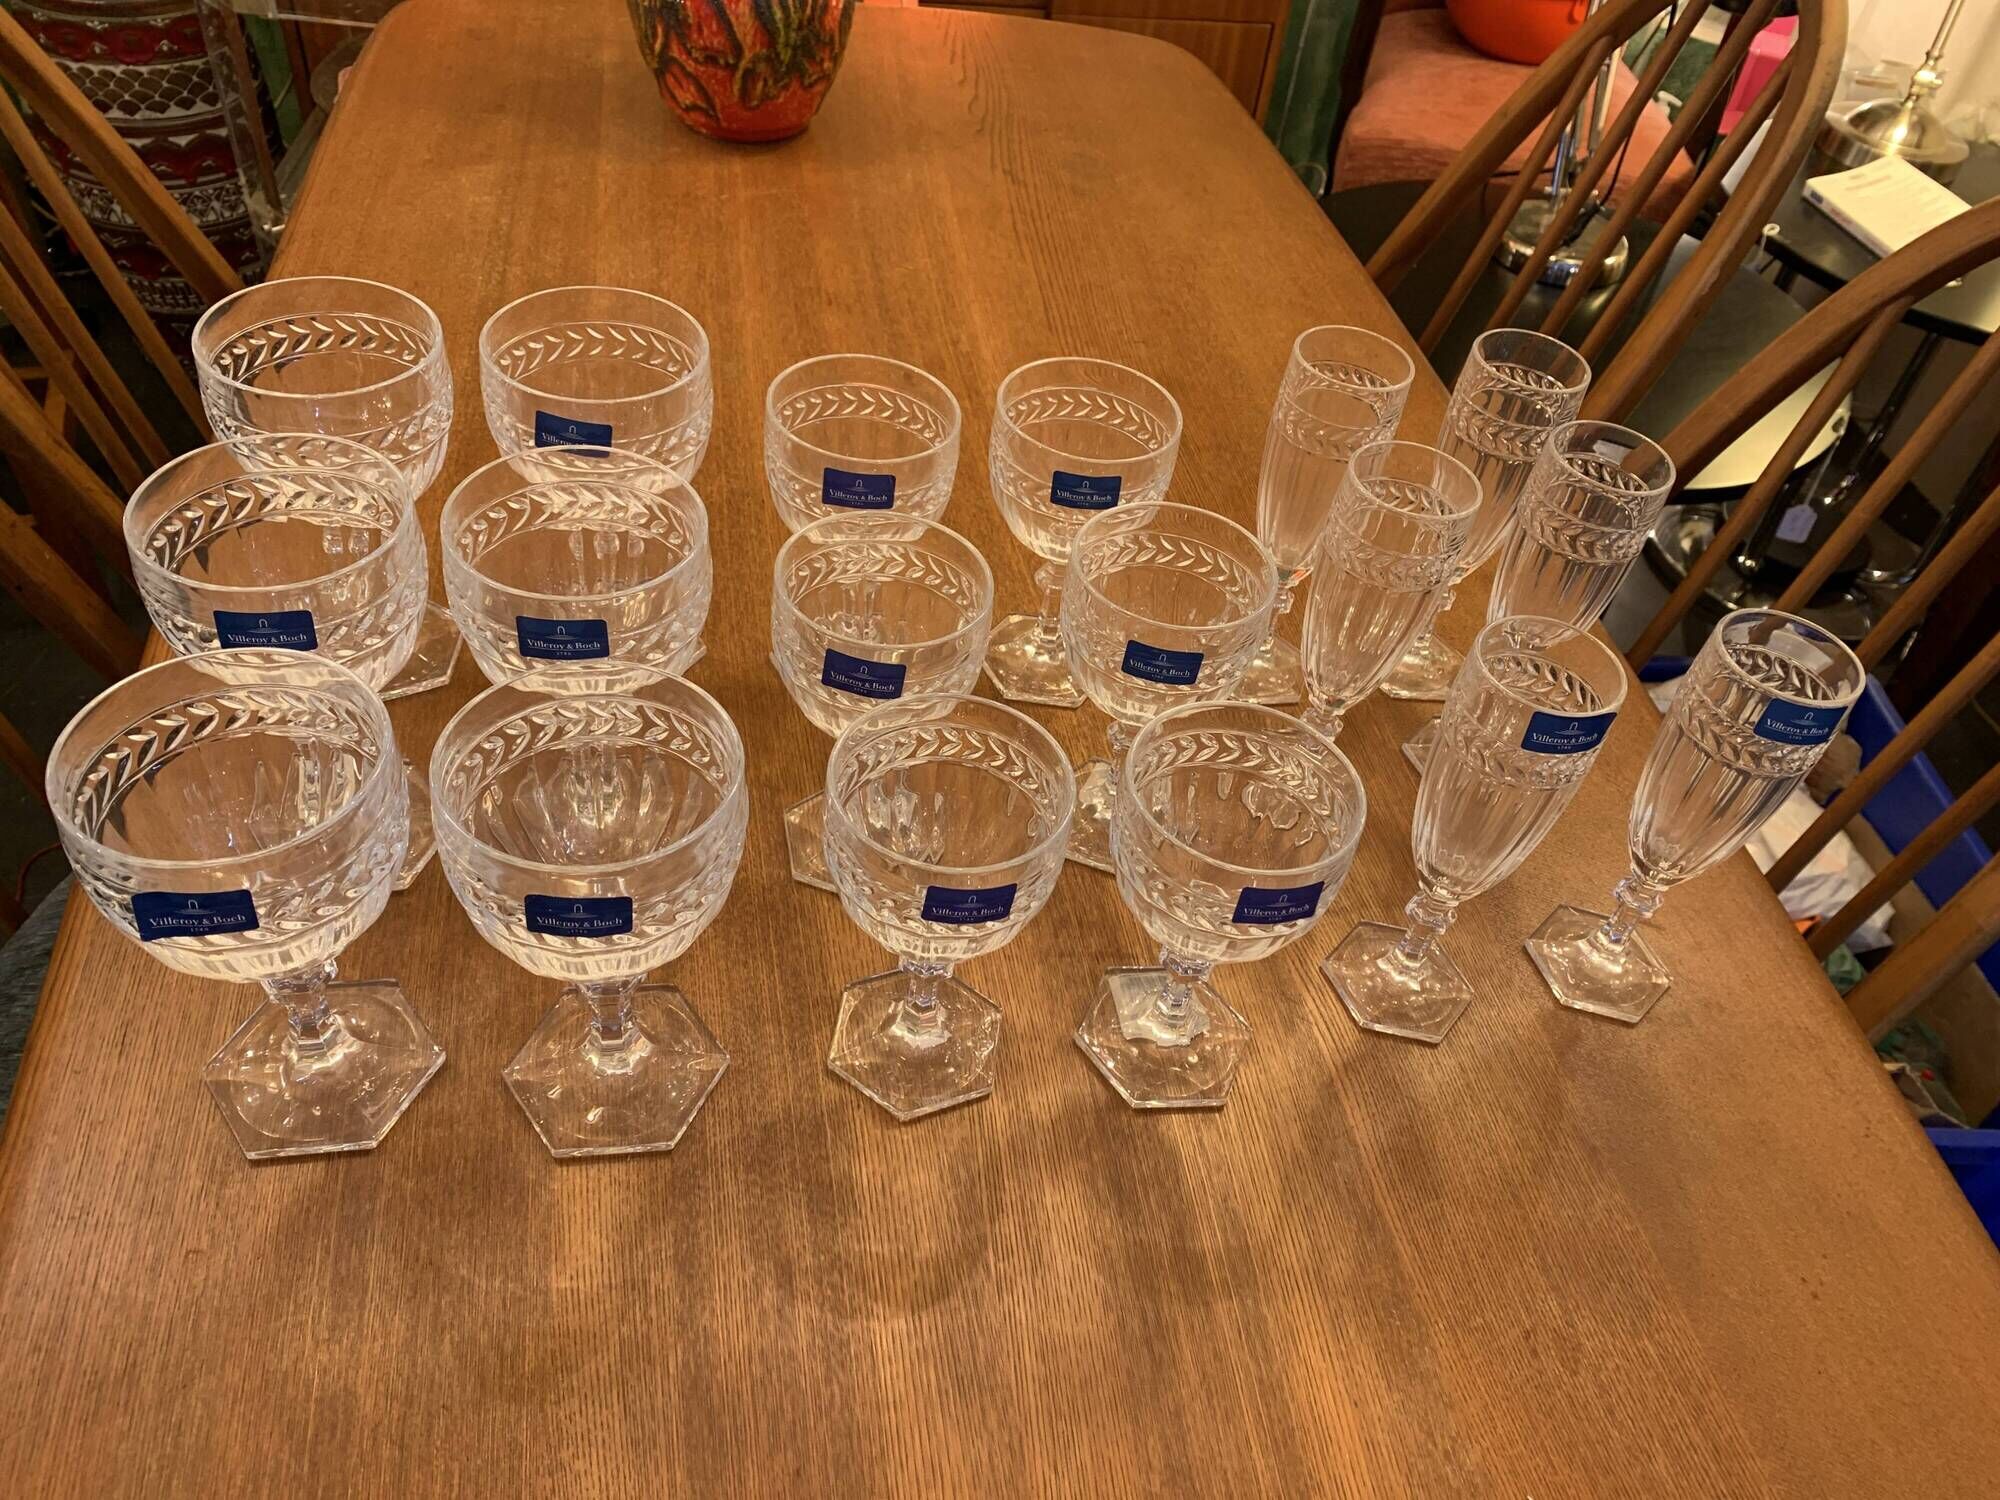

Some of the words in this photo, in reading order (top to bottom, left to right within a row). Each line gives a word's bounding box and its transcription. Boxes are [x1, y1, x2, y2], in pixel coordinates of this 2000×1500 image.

[227, 633, 268, 644] Villeroy
[280, 633, 307, 643] Boch
[527, 639, 566, 650] Villeroy
[575, 639, 601, 649] Boch
[1129, 658, 1161, 674] Villeroy
[1169, 668, 1190, 677] Boch
[830, 671, 862, 687] Villeroy
[872, 683, 895, 691] Boch
[1766, 718, 1801, 734] Villeroy
[1532, 732, 1568, 745] Villeroy
[149, 917, 200, 927] Villeroy
[213, 914, 246, 924] Boch
[536, 916, 580, 927] Villeroy
[593, 917, 623, 927] Boch
